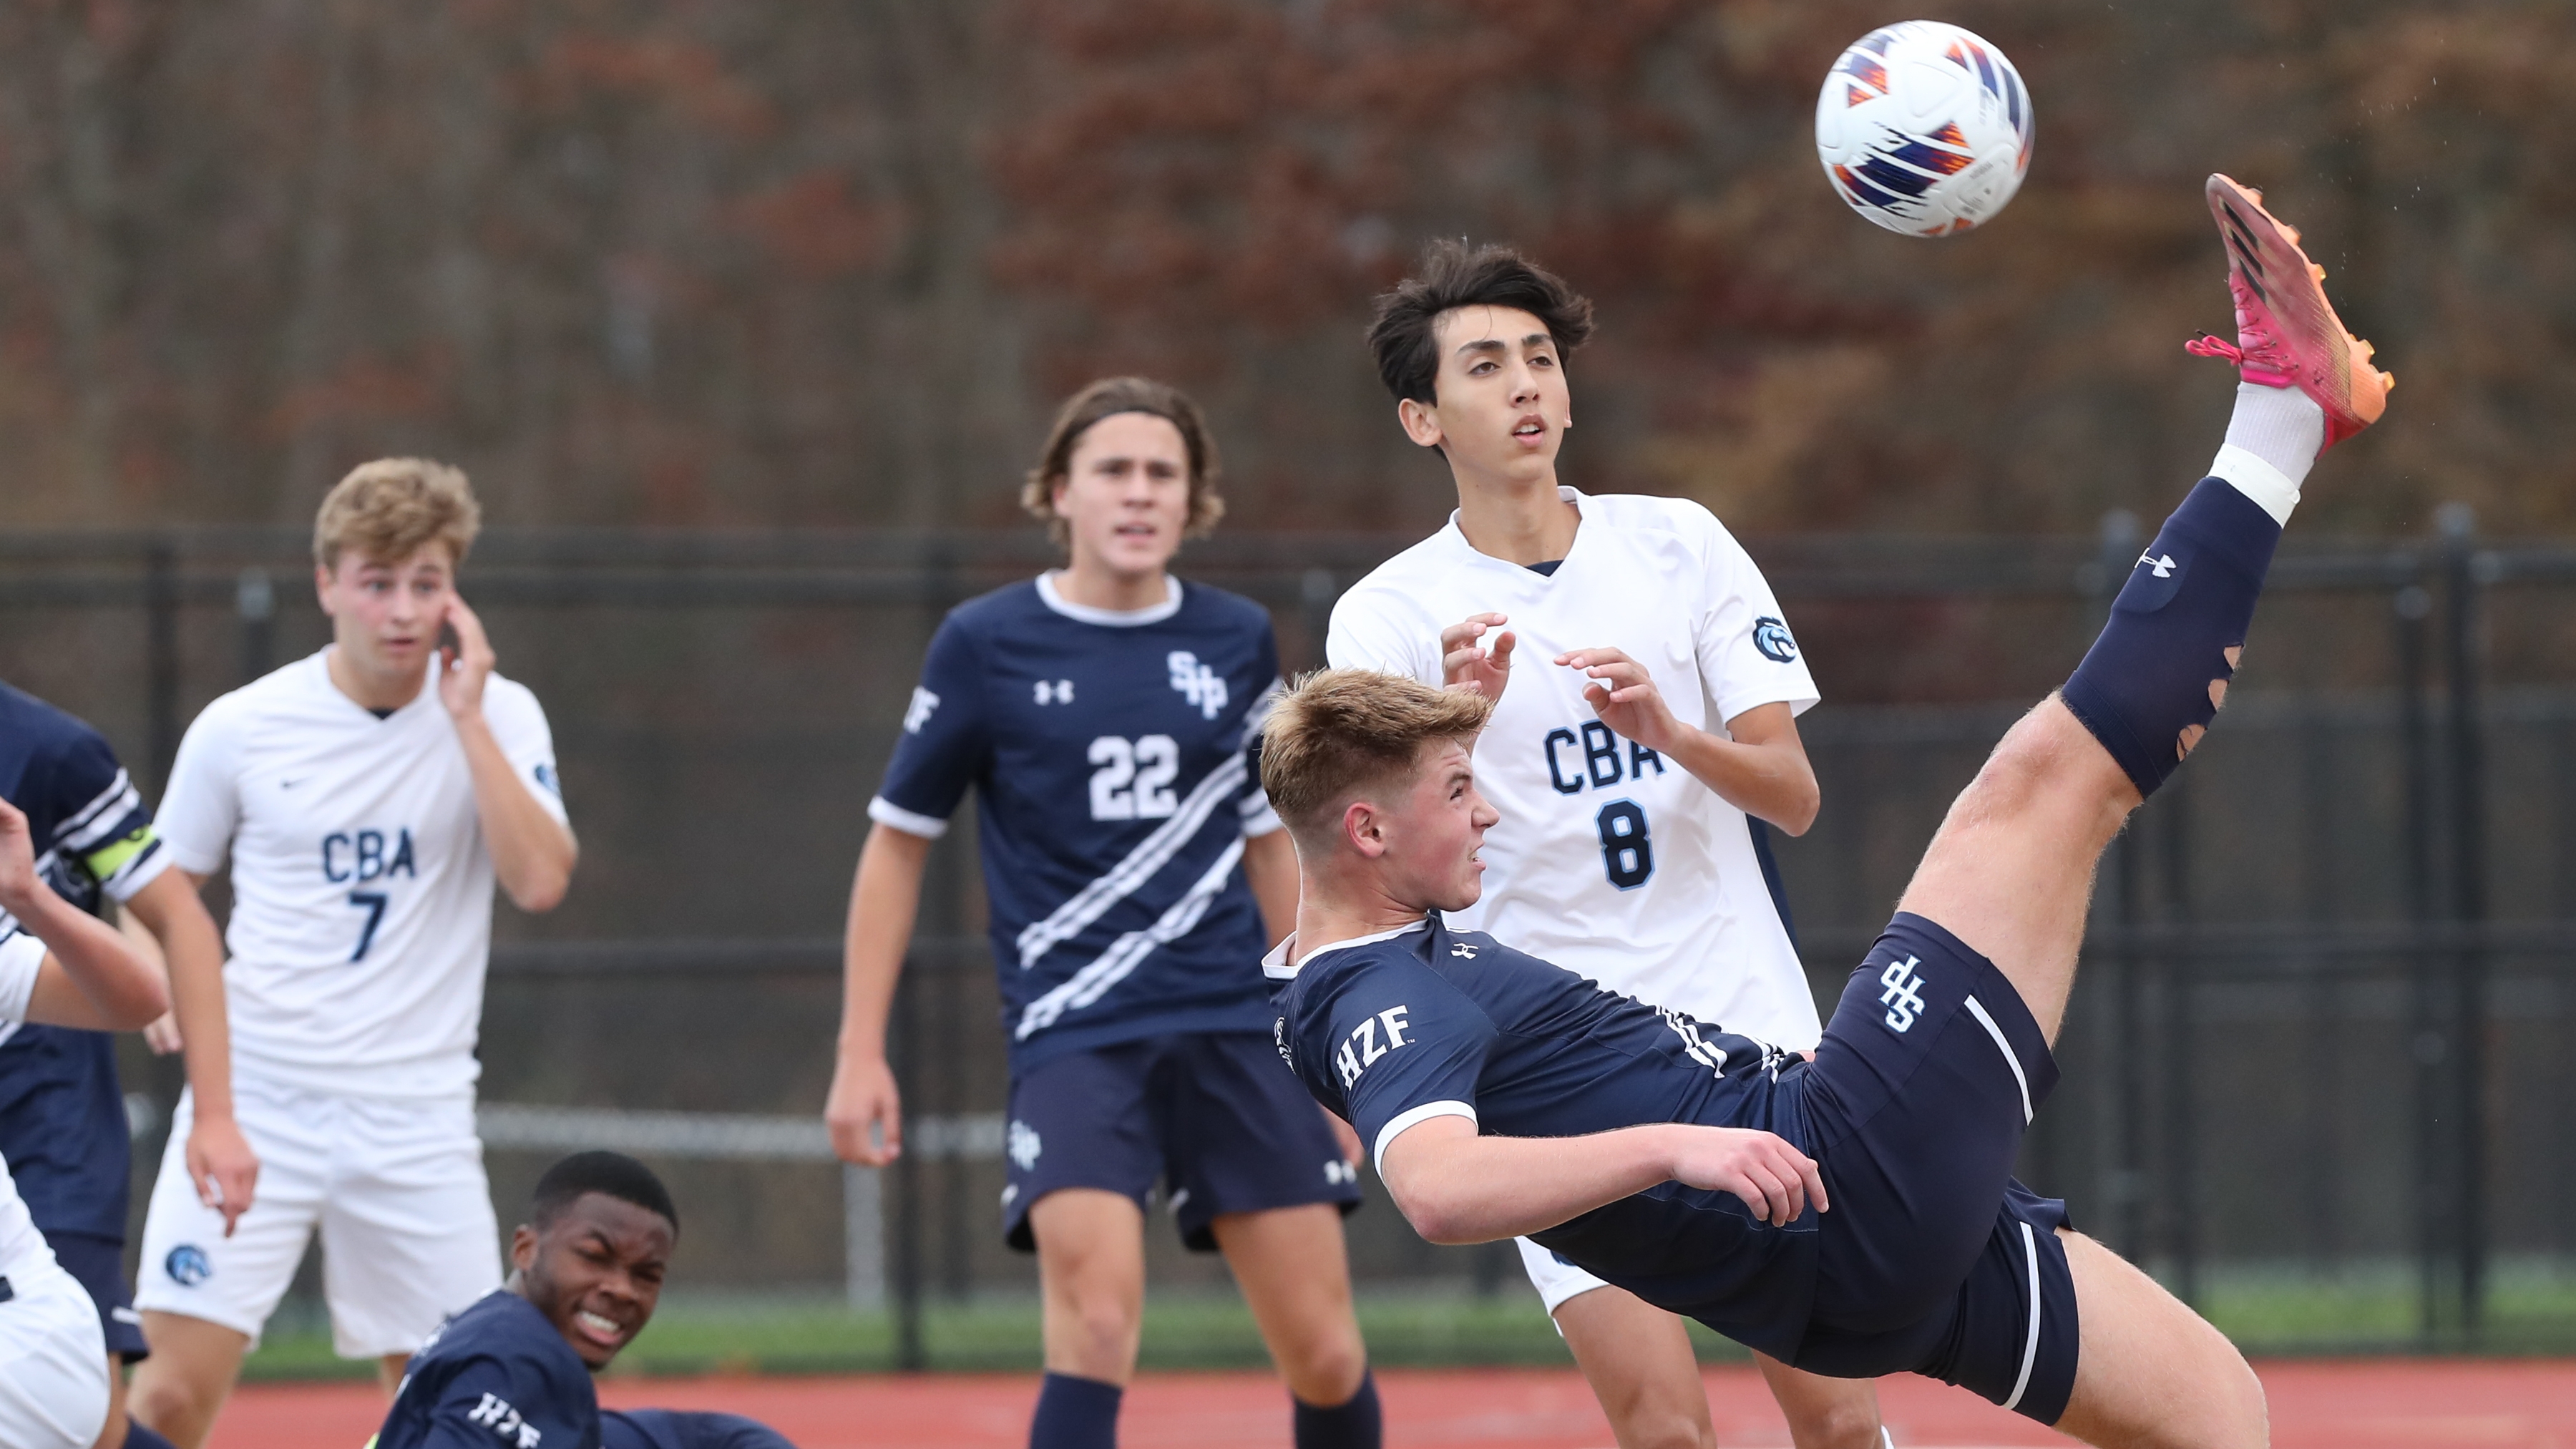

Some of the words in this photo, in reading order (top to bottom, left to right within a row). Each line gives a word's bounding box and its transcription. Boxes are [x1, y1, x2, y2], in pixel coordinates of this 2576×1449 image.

[1087, 733, 1180, 821] 22
[1543, 718, 1668, 797] CBA
[323, 827, 416, 884] CBA
[1594, 796, 1656, 892] 8
[348, 892, 389, 963] 7
[1336, 1004, 1410, 1092] HZF
